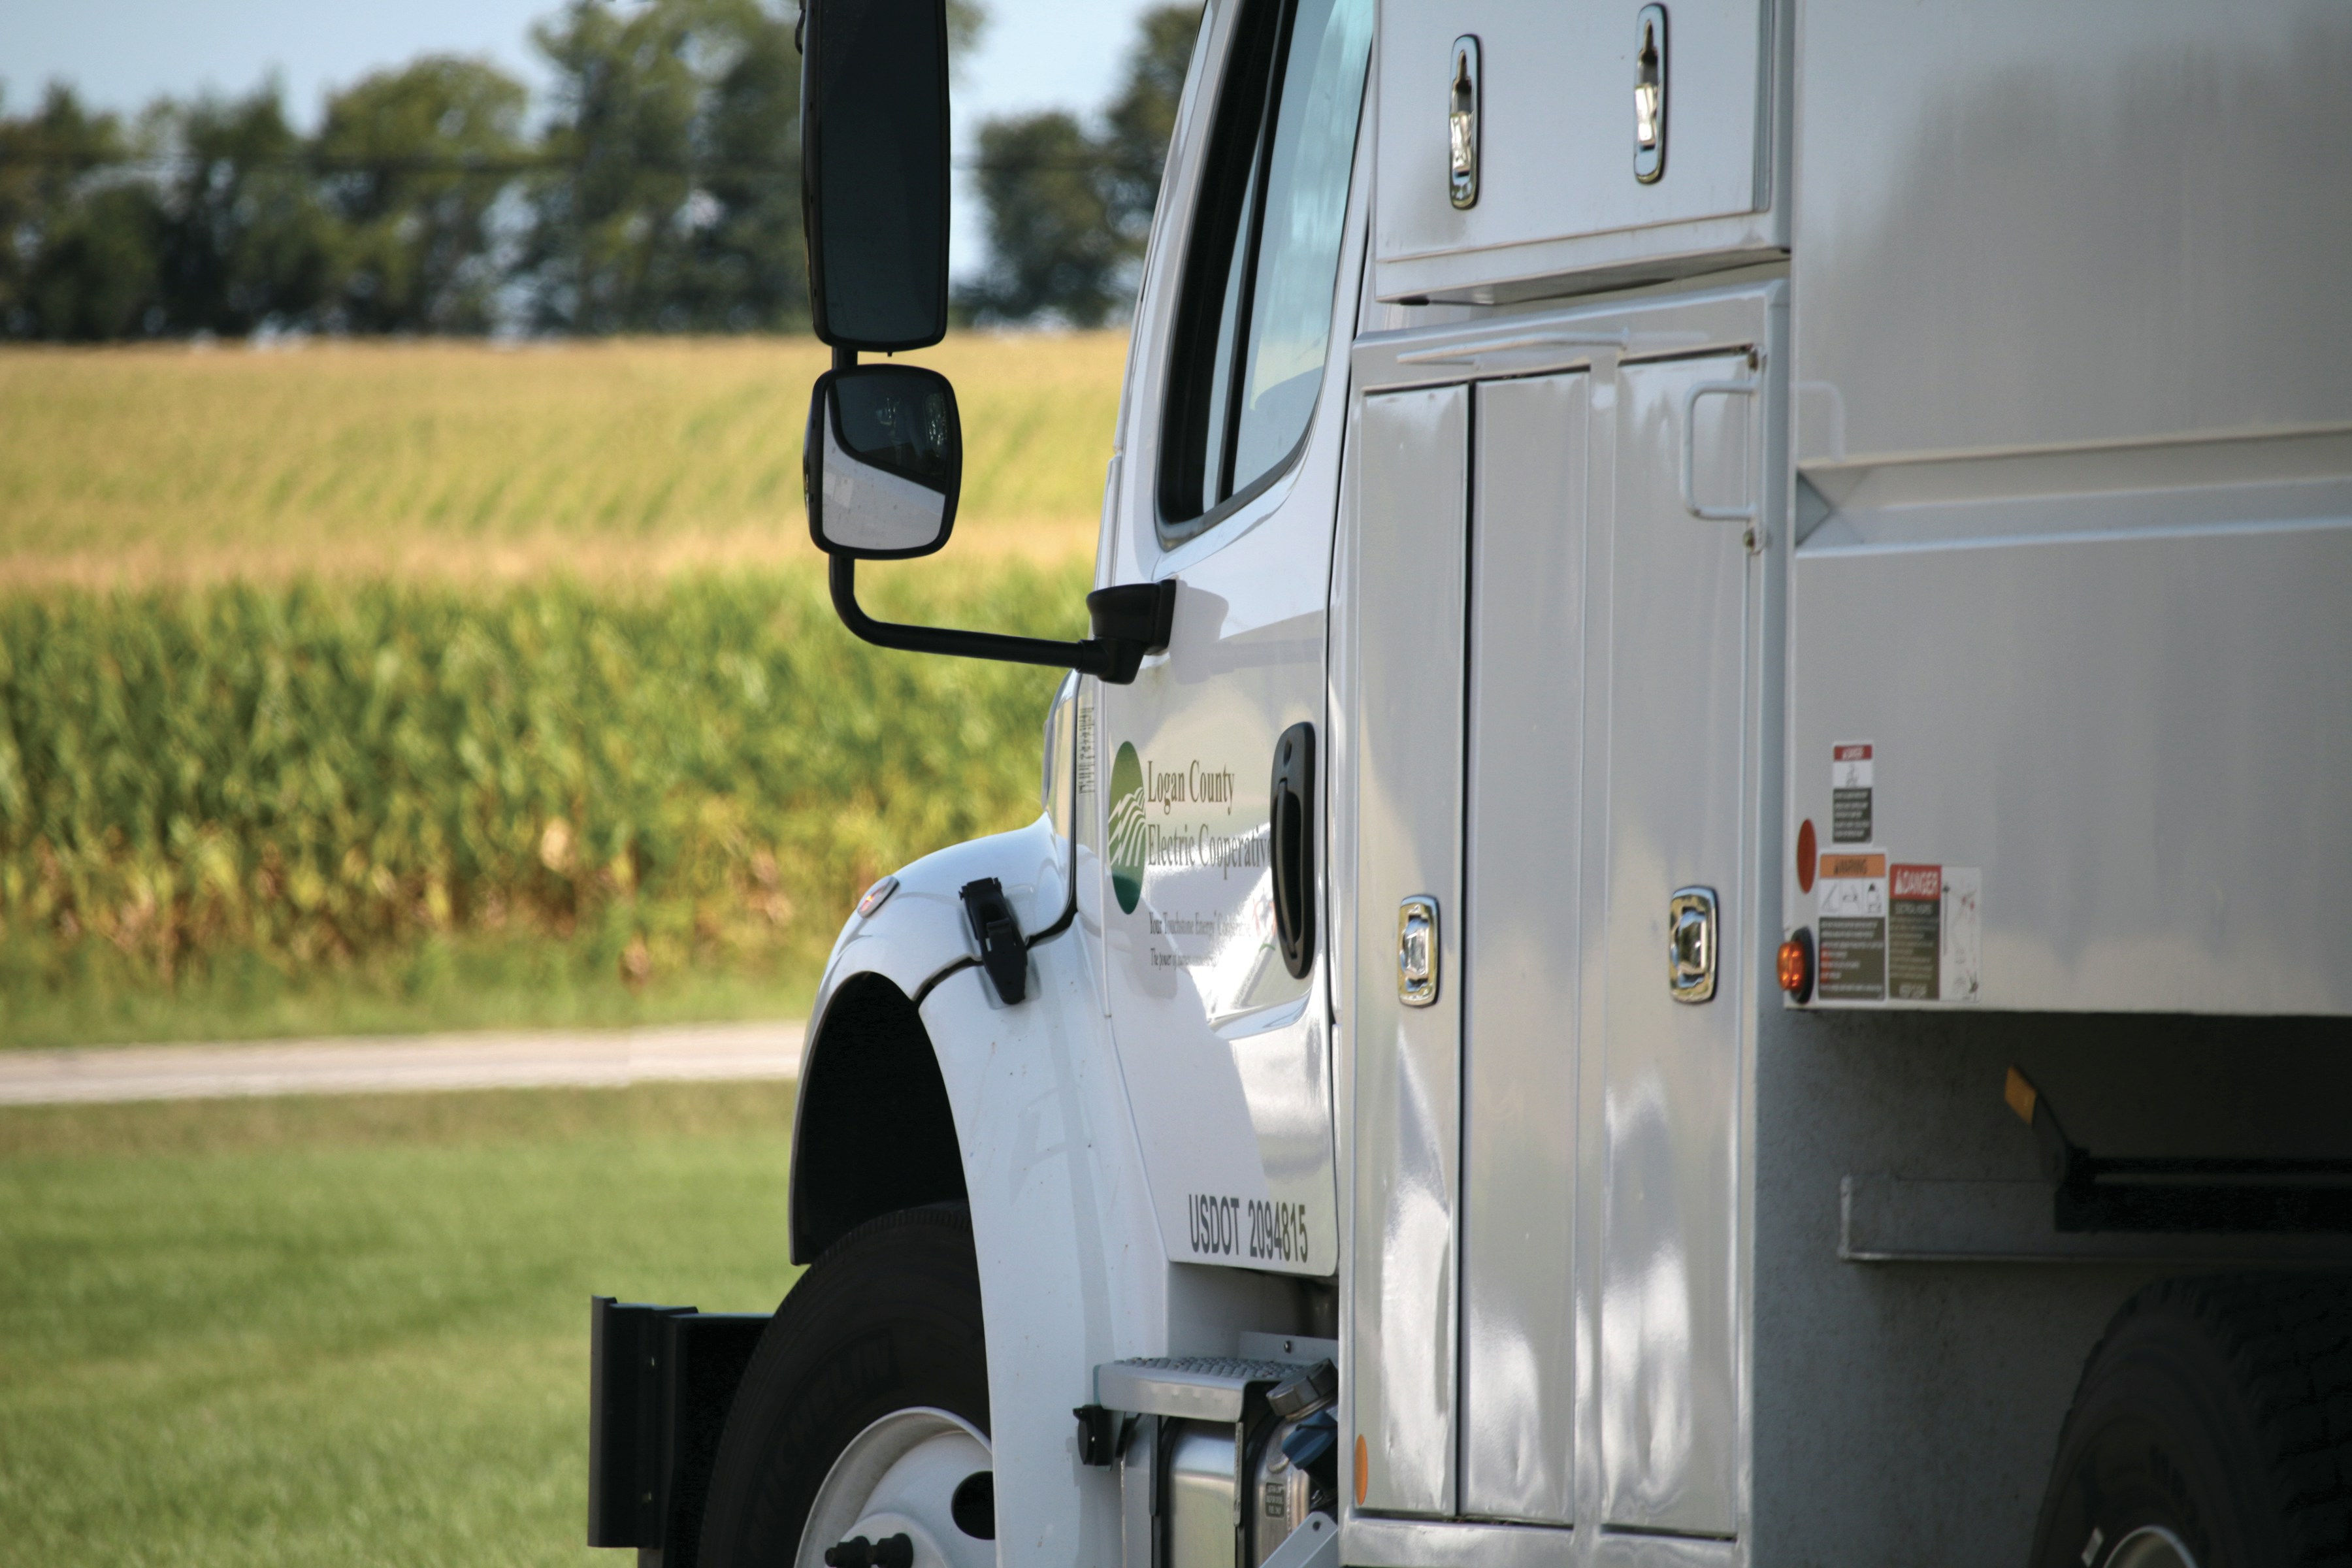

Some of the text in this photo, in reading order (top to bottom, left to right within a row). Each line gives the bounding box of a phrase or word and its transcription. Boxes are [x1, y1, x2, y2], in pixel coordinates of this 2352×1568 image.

[1147, 760, 1234, 815] Logan County
[1148, 824, 1195, 866] Electric
[1903, 870, 1938, 896] DANGER
[1149, 911, 1162, 934] Your
[1151, 947, 1159, 966] The
[1189, 1194, 1308, 1263] USDOT 2094815
